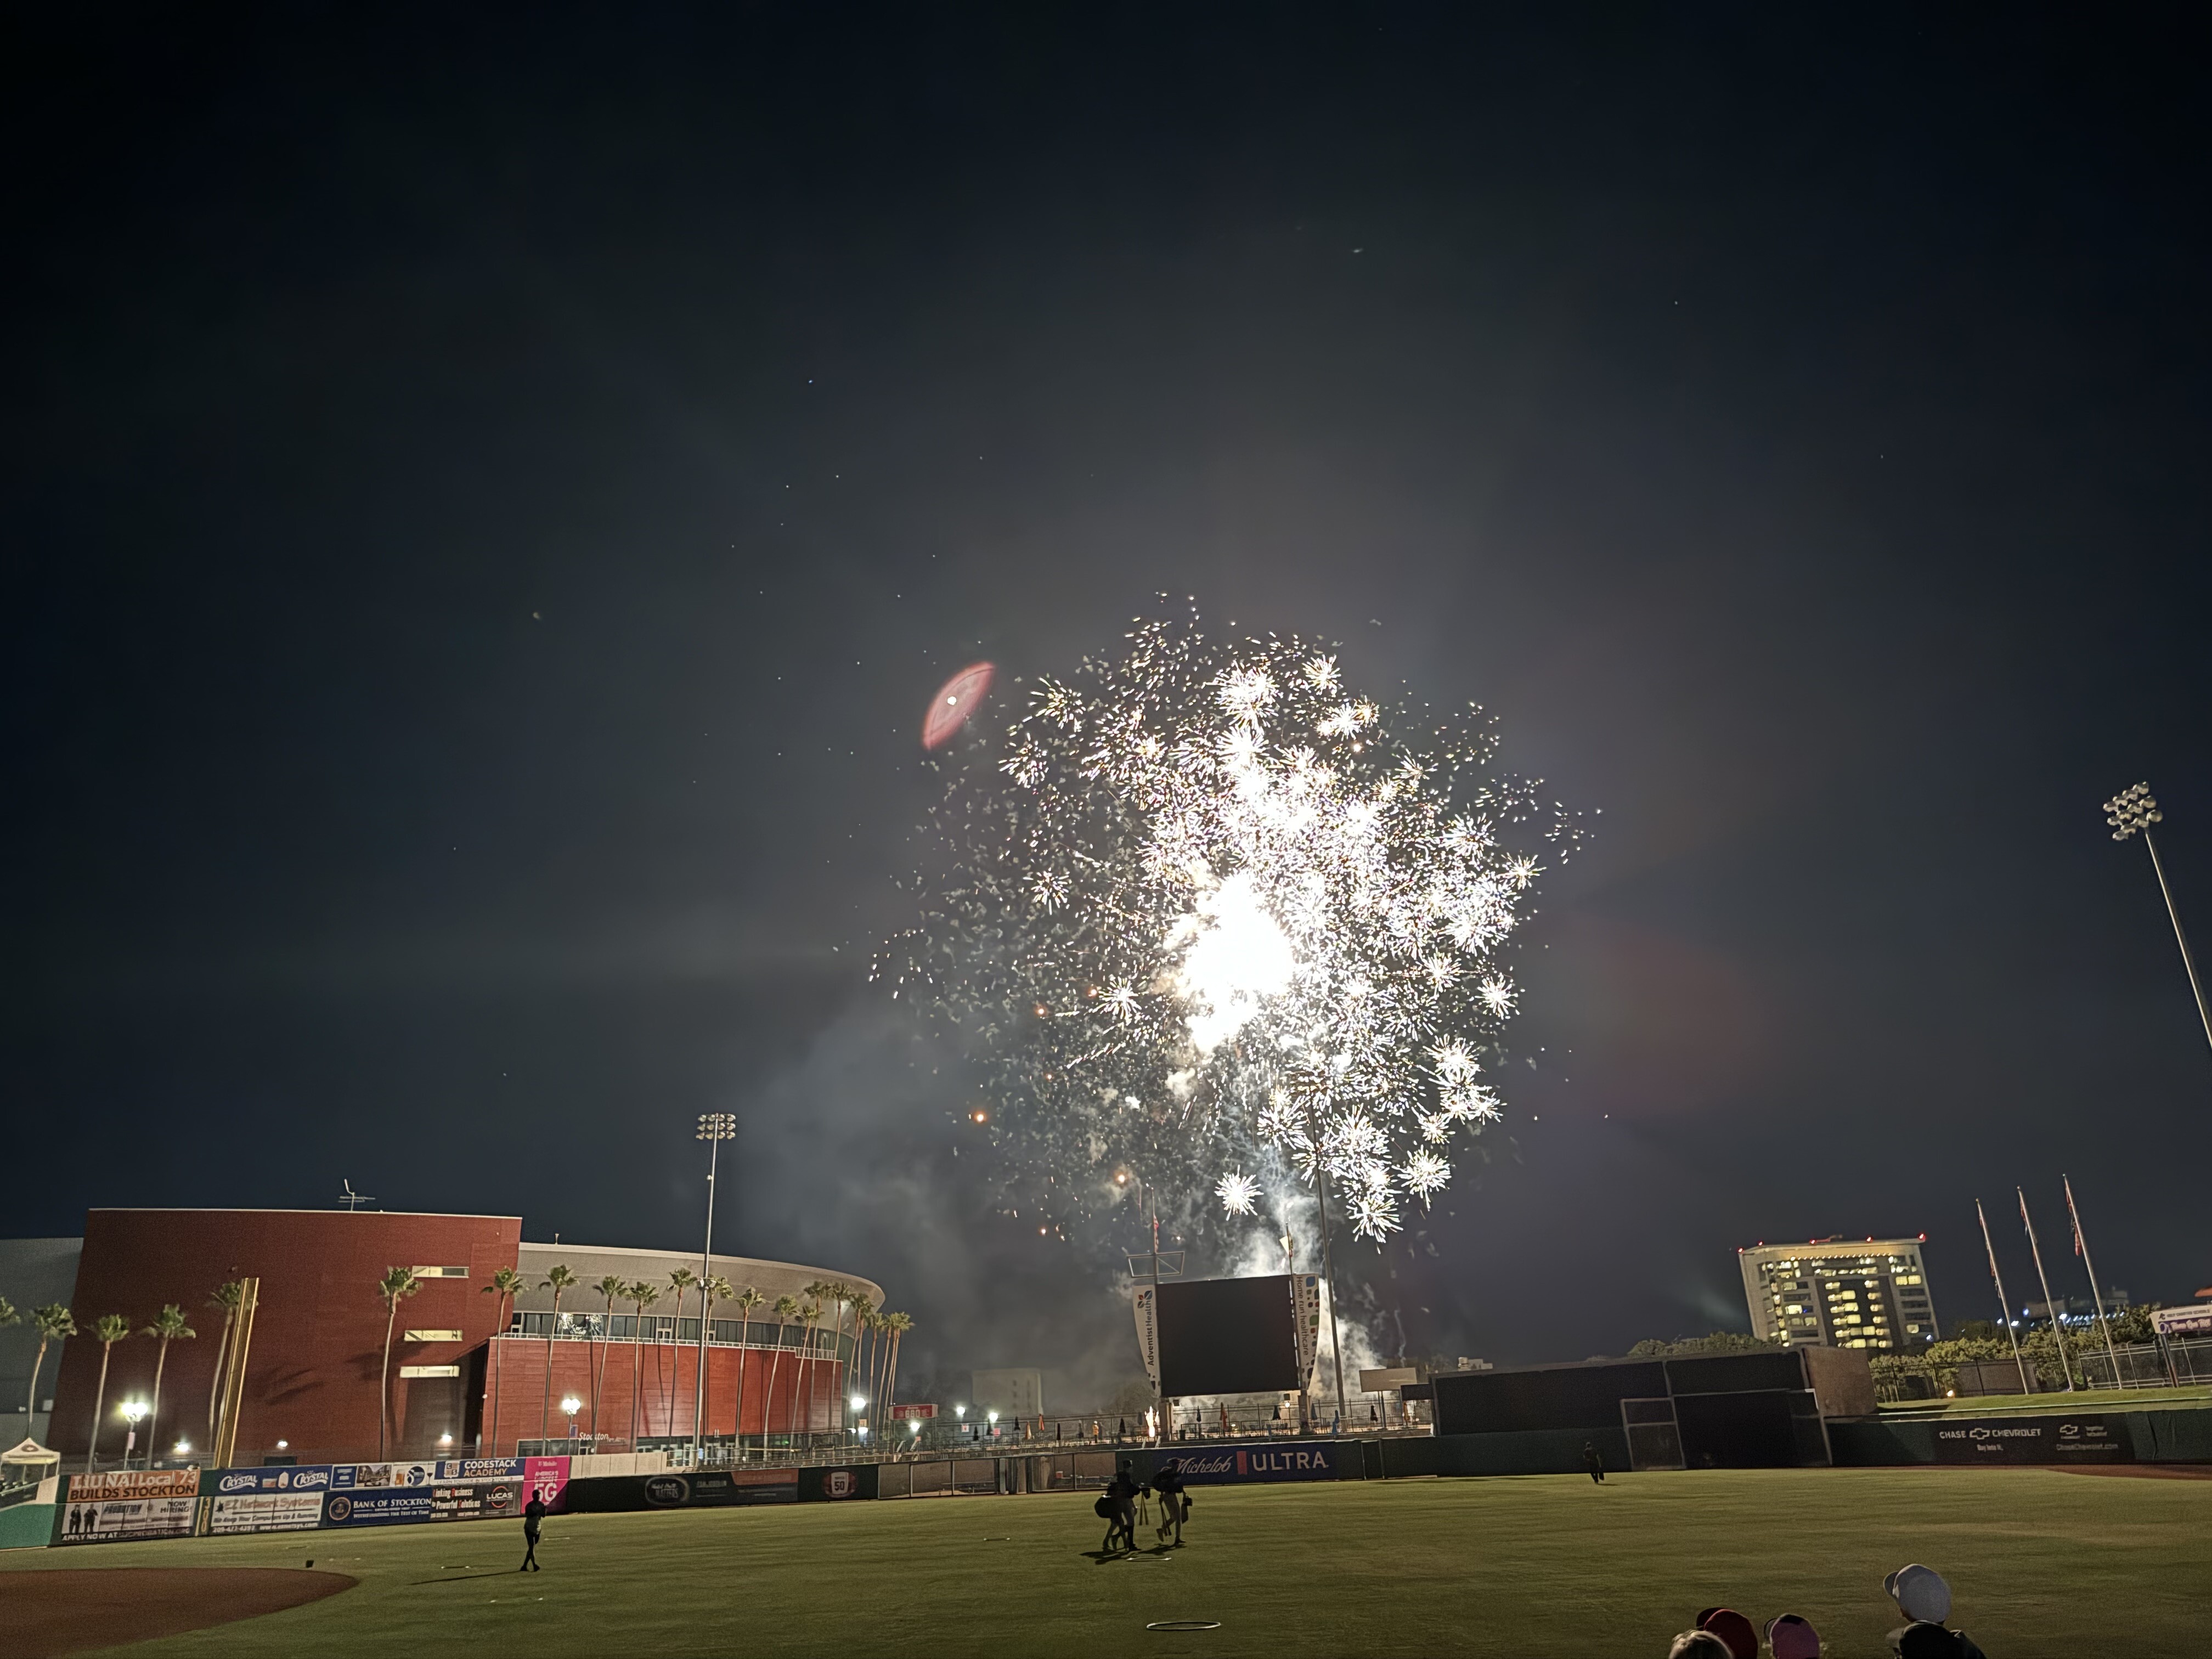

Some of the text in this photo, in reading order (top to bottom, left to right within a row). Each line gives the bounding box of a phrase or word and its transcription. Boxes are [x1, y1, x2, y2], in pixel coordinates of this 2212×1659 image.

[1300, 1316, 1310, 1356] healthcare
[1939, 1428, 2041, 1439] CHASE CHEVROLET
[464, 1459, 517, 1469] CODESTACK
[1252, 1451, 1327, 1471] ULTRA
[137, 1471, 176, 1486] Local
[178, 1470, 198, 1485] 73
[463, 1468, 507, 1477] ACADEMY
[219, 1475, 258, 1492] CRYSTAL
[292, 1471, 329, 1488] CRYSTAL
[834, 1481, 845, 1491] 50
[69, 1484, 195, 1500] BUILDS STOCKTON
[534, 1482, 557, 1503] 5G
[353, 1500, 375, 1509] BANK
[391, 1498, 432, 1507] STOCKTON
[436, 1499, 458, 1510] Powerful
[61, 1532, 84, 1542] APPLY
